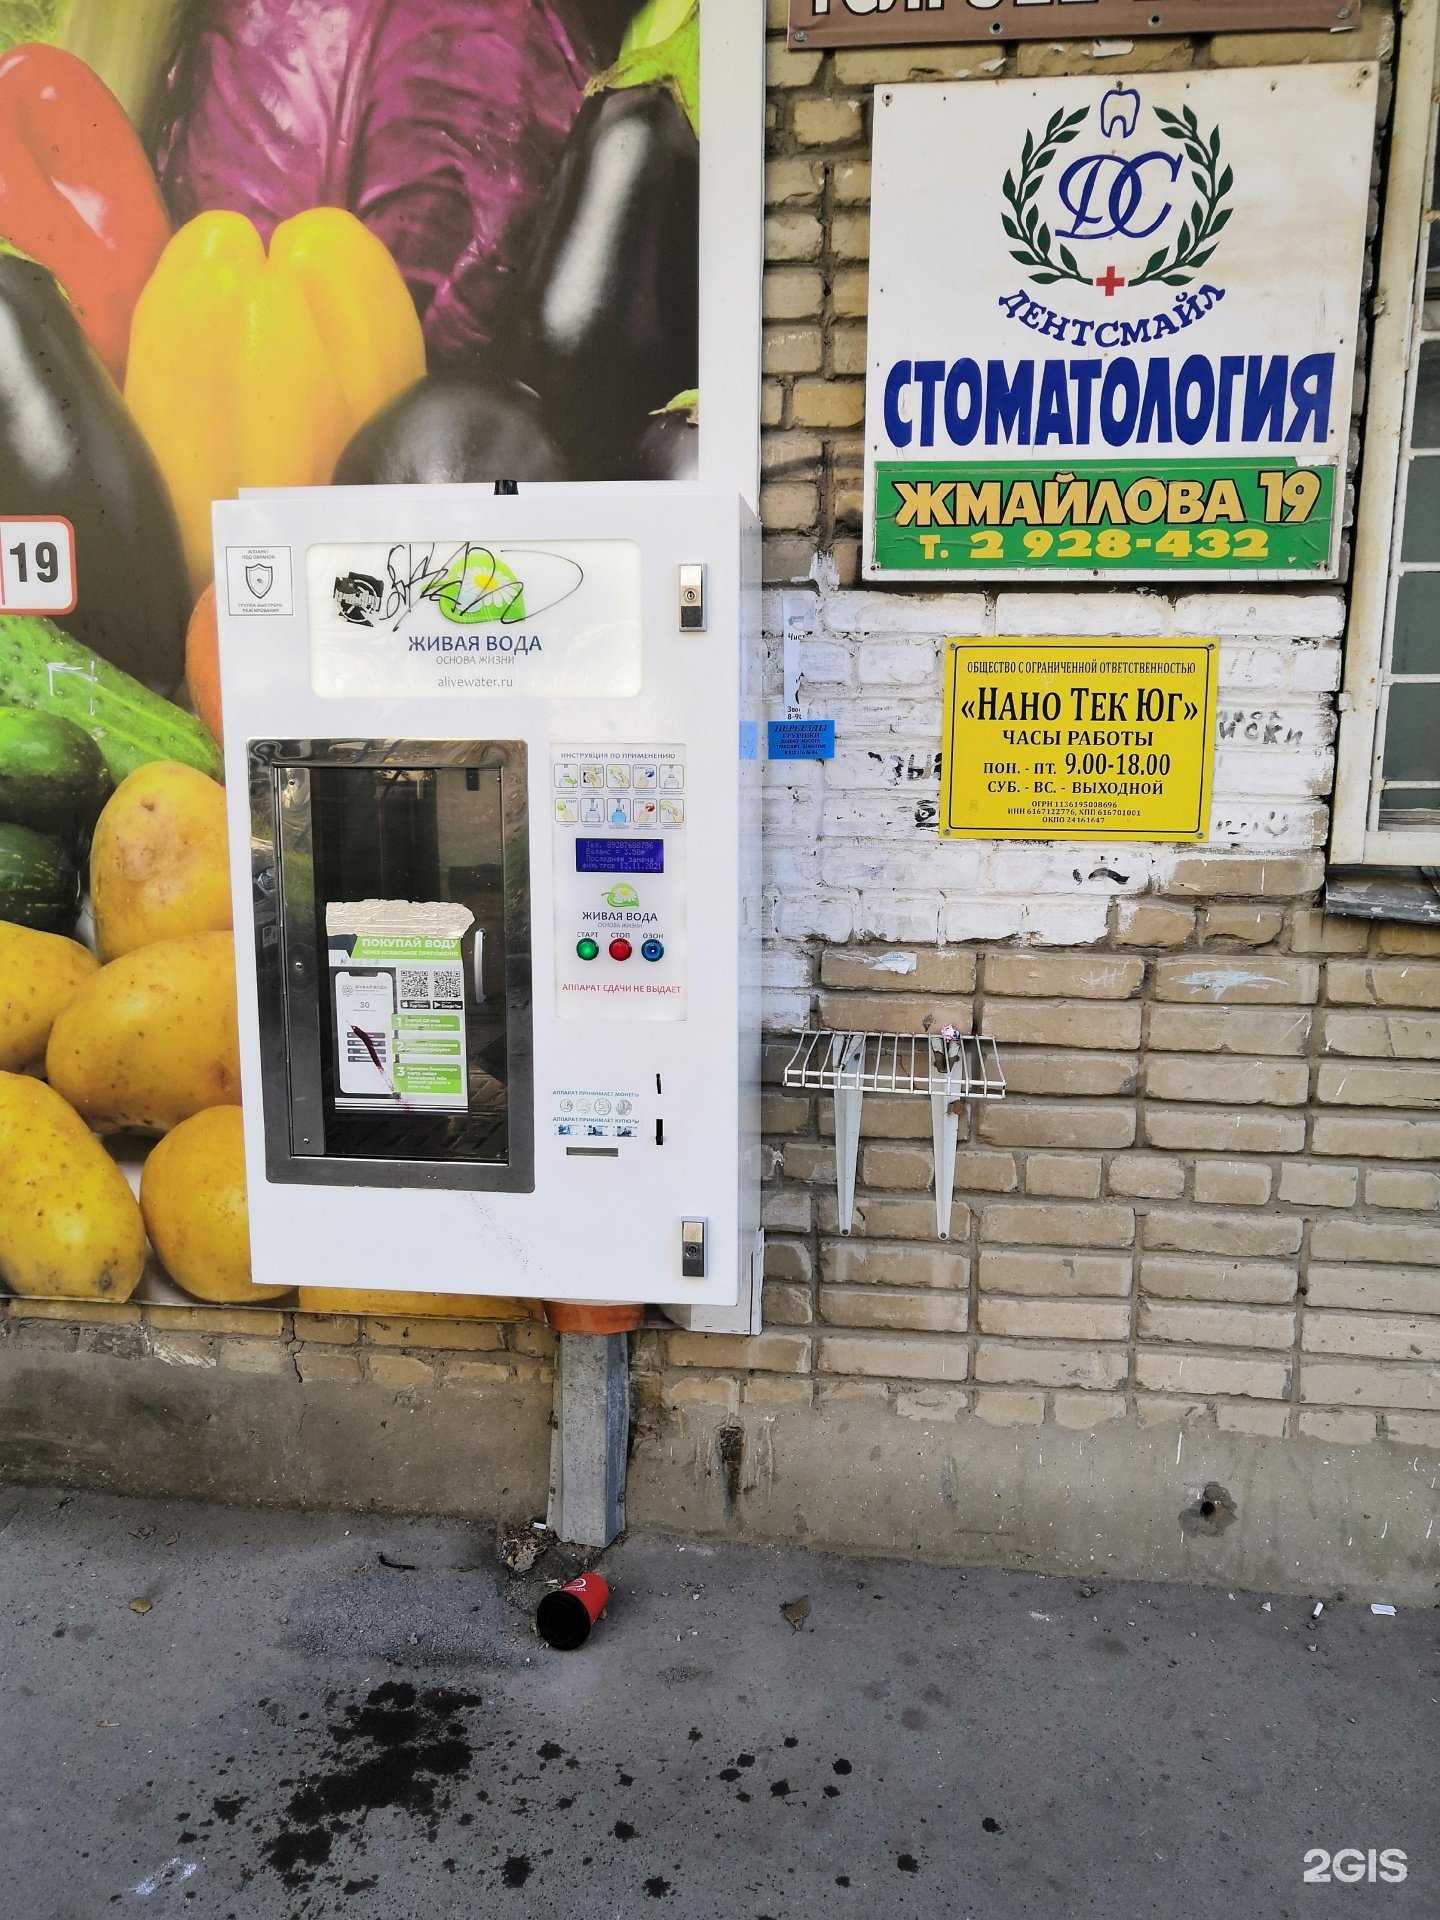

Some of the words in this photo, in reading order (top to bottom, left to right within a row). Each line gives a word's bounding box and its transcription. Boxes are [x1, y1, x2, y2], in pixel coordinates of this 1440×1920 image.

[998, 284, 1226, 348] ДЕНТСМАЙЛ
[883, 352, 1336, 448] СТОМАТОЛОГИЯ
[891, 471, 1248, 527] ЖМАЙЛОВА
[1257, 469, 1322, 524] 19
[969, 530, 1005, 560] 2
[1022, 528, 1269, 560] 928-432
[9, 541, 59, 583] 19
[408, 635, 480, 651] ЖИВАЯ
[486, 635, 543, 656] ВОДА
[436, 655, 476, 665] ОСНОВА
[479, 655, 515, 665] ЖИЗНИ
[967, 661, 1016, 674] ОБЩЕСТВО
[1018, 661, 1024, 674] С
[1025, 659, 1097, 674] ОГРАНИЧЕННОЙ
[1100, 662, 1196, 675] ОТВЕТСТВЕННОСТЬЮ
[437, 676, 513, 688] alivewater.ru
[1003, 730, 1061, 746] ЧАСЫ
[1067, 730, 1154, 747] РАБОТЫ
[983, 762, 1021, 775] ПОН.
[1033, 762, 1057, 775] ПТ.
[1065, 752, 1171, 776] 9.00-18.00
[987, 780, 1021, 794] СУБ.
[1033, 781, 1057, 794] ВС.
[1071, 780, 1164, 796] ВЫХОДНОЙ
[1031, 800, 1053, 808] ОГРН
[582, 911, 623, 920] ЖИВАЯ
[626, 912, 659, 923] ВОДА
[362, 936, 422, 949] ПОКУПАЙ
[424, 938, 458, 949] ВОДУ
[561, 983, 601, 992] АППАРАТ
[603, 984, 632, 994] СДАЧИ
[633, 985, 645, 993] НЕ
